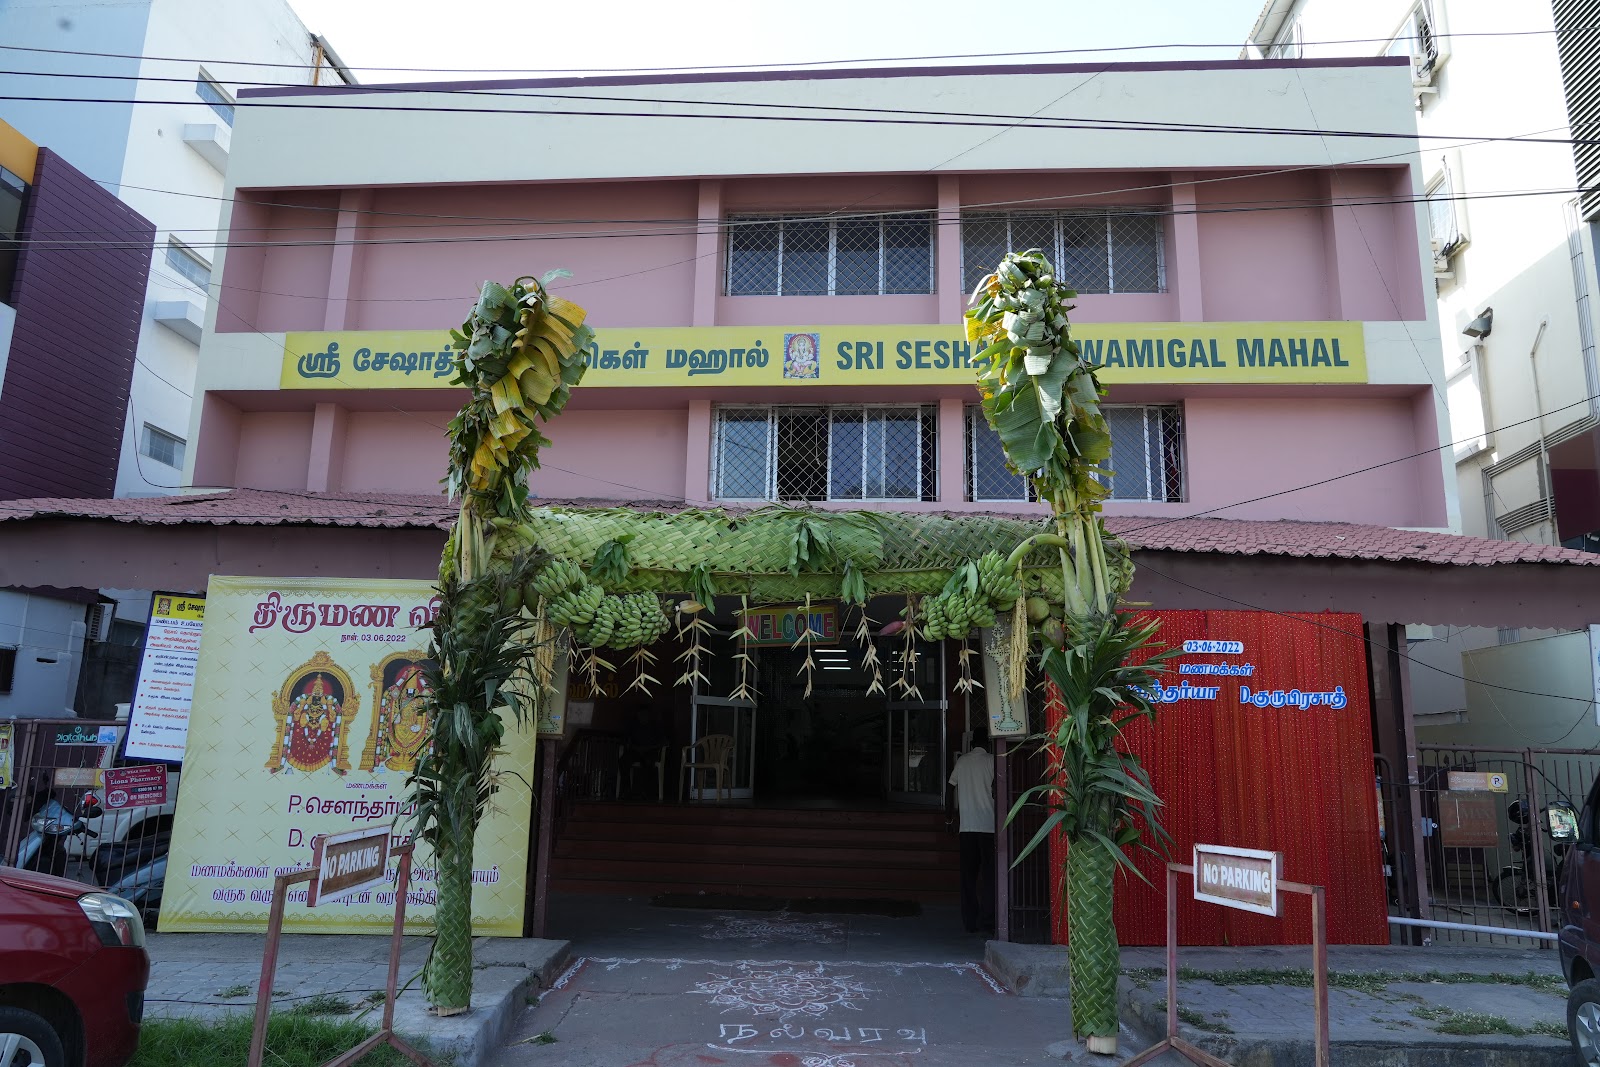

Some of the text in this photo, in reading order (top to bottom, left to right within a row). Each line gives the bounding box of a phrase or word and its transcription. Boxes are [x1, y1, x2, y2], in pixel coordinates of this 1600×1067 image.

[665, 339, 769, 376] மஹால்
[836, 338, 1350, 370] SRI SESHA WAMIGAL MAHAL
[248, 591, 401, 634] திருமண
[361, 633, 407, 643] 03.06.2022
[743, 612, 835, 642] WELCOME
[1179, 661, 1255, 677] மணமக்கள்
[1240, 685, 1348, 711] D.குருபிரசாத்
[130, 775, 162, 783] Pharmacy
[191, 861, 270, 878] மணமக்களை
[322, 854, 337, 881] NO
[337, 845, 380, 877] PARKING
[1203, 862, 1271, 894] NO PARKING
[250, 889, 274, 904] வரு
[718, 1023, 927, 1046] நல்வரவு
